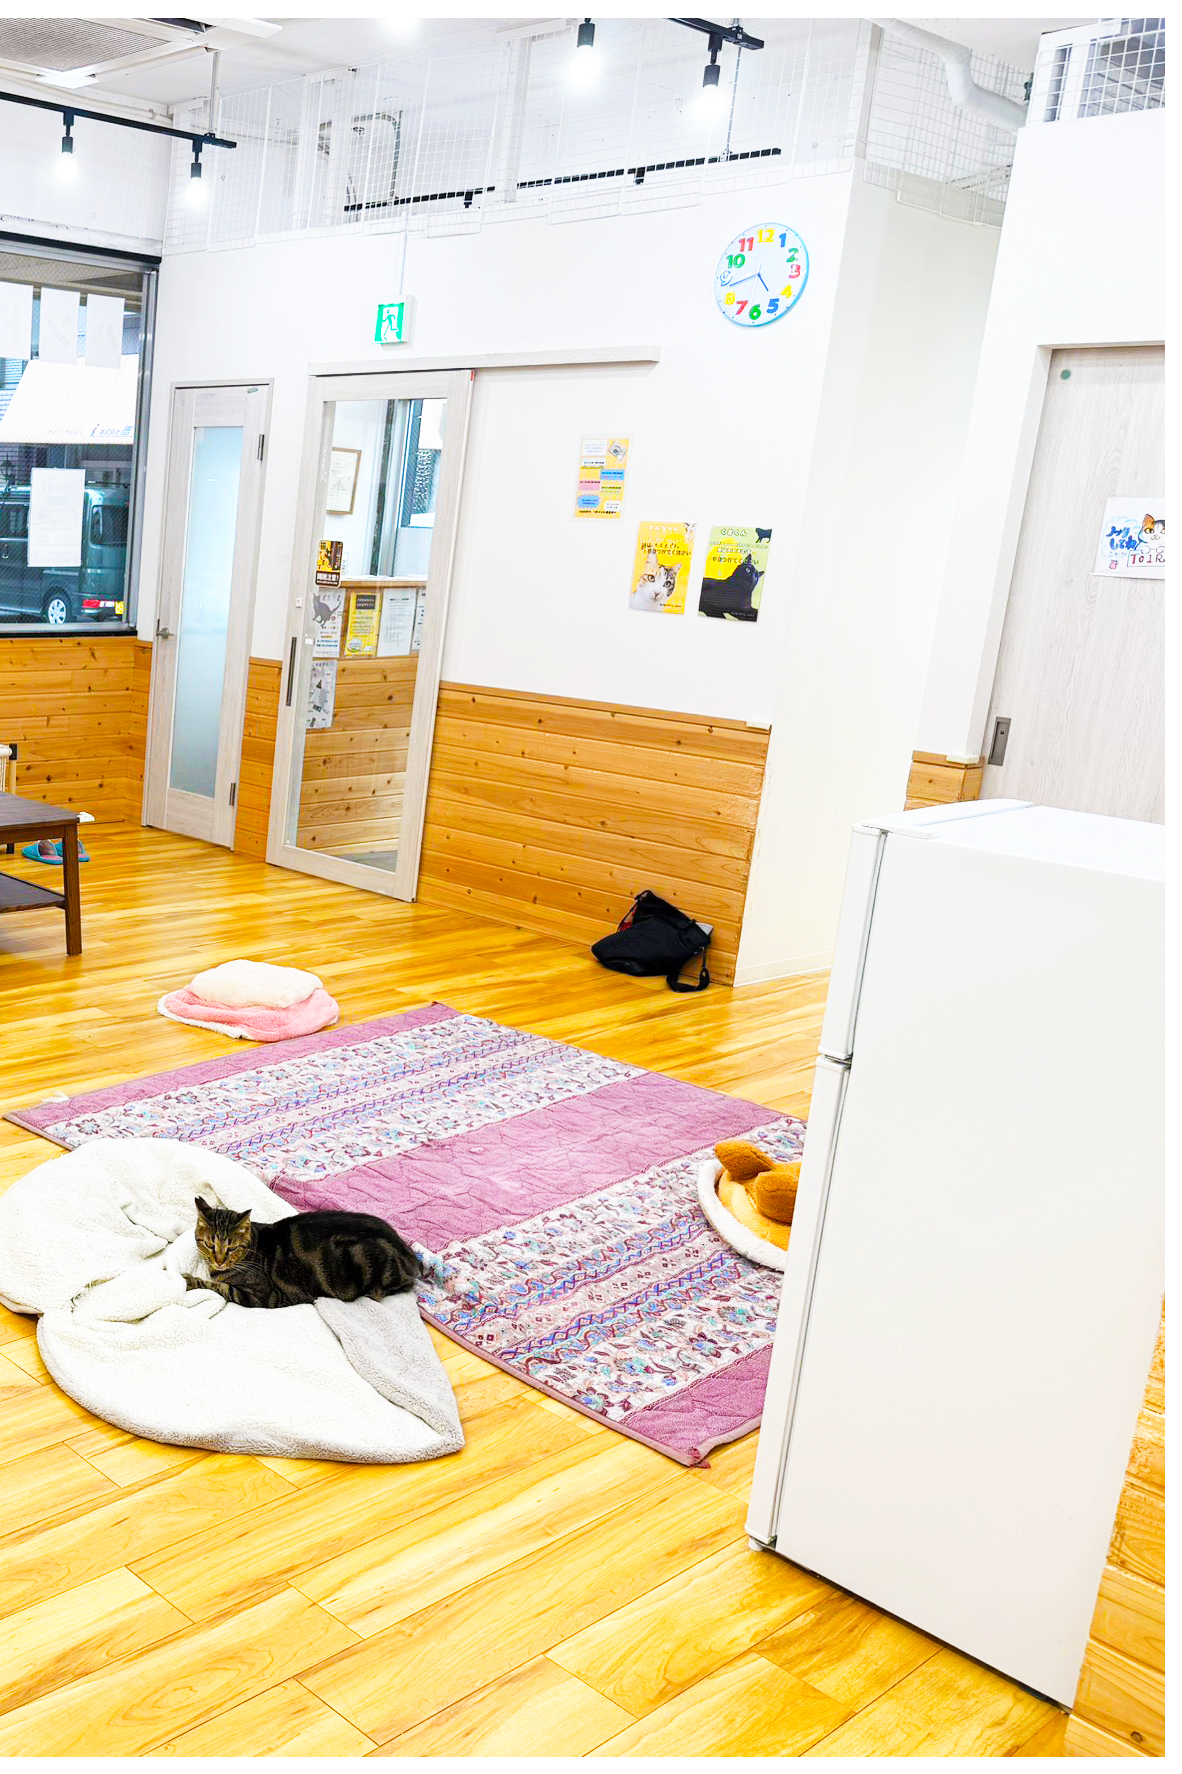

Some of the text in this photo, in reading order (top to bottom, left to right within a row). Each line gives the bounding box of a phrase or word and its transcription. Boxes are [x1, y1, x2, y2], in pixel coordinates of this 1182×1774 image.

[757, 228, 775, 243] 12
[779, 233, 787, 248] 1
[738, 237, 754, 252] 11
[726, 253, 746, 269] 10
[786, 247, 799, 263] 2
[720, 270, 732, 287] 9
[788, 263, 801, 279] 3
[724, 290, 736, 306] 8
[780, 284, 793, 299] 4
[735, 299, 749, 315] 7
[749, 303, 762, 320] 6
[766, 298, 780, 314] 5
[1109, 535, 1137, 550] してね
